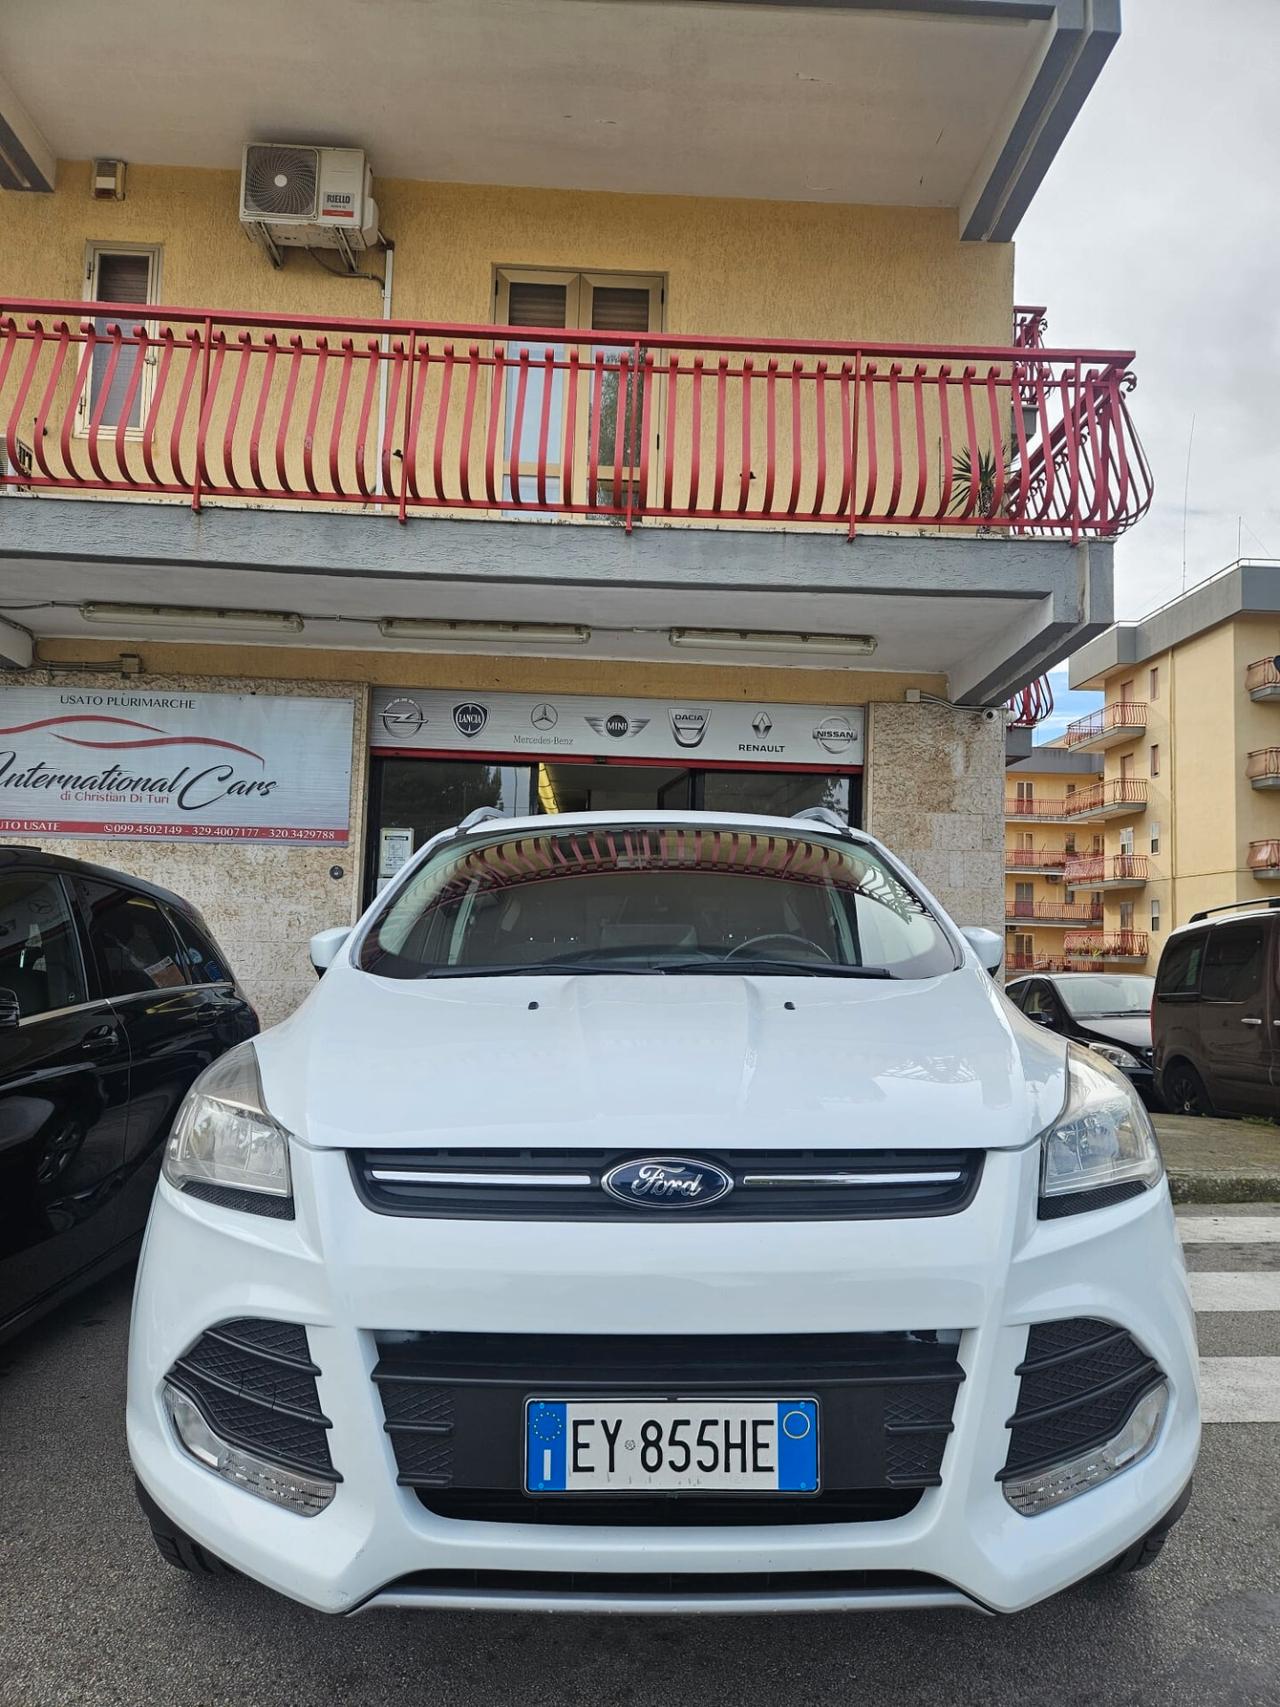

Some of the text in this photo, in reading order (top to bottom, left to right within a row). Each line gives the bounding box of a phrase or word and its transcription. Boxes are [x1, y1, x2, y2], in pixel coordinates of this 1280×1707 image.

[327, 194, 351, 204] RIELLO
[60, 695, 197, 709] USATO PLURIMARCHE
[458, 713, 482, 723] LANCIA
[607, 723, 627, 731] MINI
[513, 735, 574, 745] Mercedes-Benz
[738, 744, 785, 753] RENAULT
[177, 765, 277, 810] Cars
[60, 791, 169, 804] di Christian Di Turi
[24, 821, 60, 831] USATE
[114, 824, 182, 835] 099.4502149
[192, 827, 259, 837] 329.4007177
[269, 830, 335, 840] 320.3429788
[631, 1165, 703, 1197] Ford
[572, 1419, 775, 1473] EY 855HE
